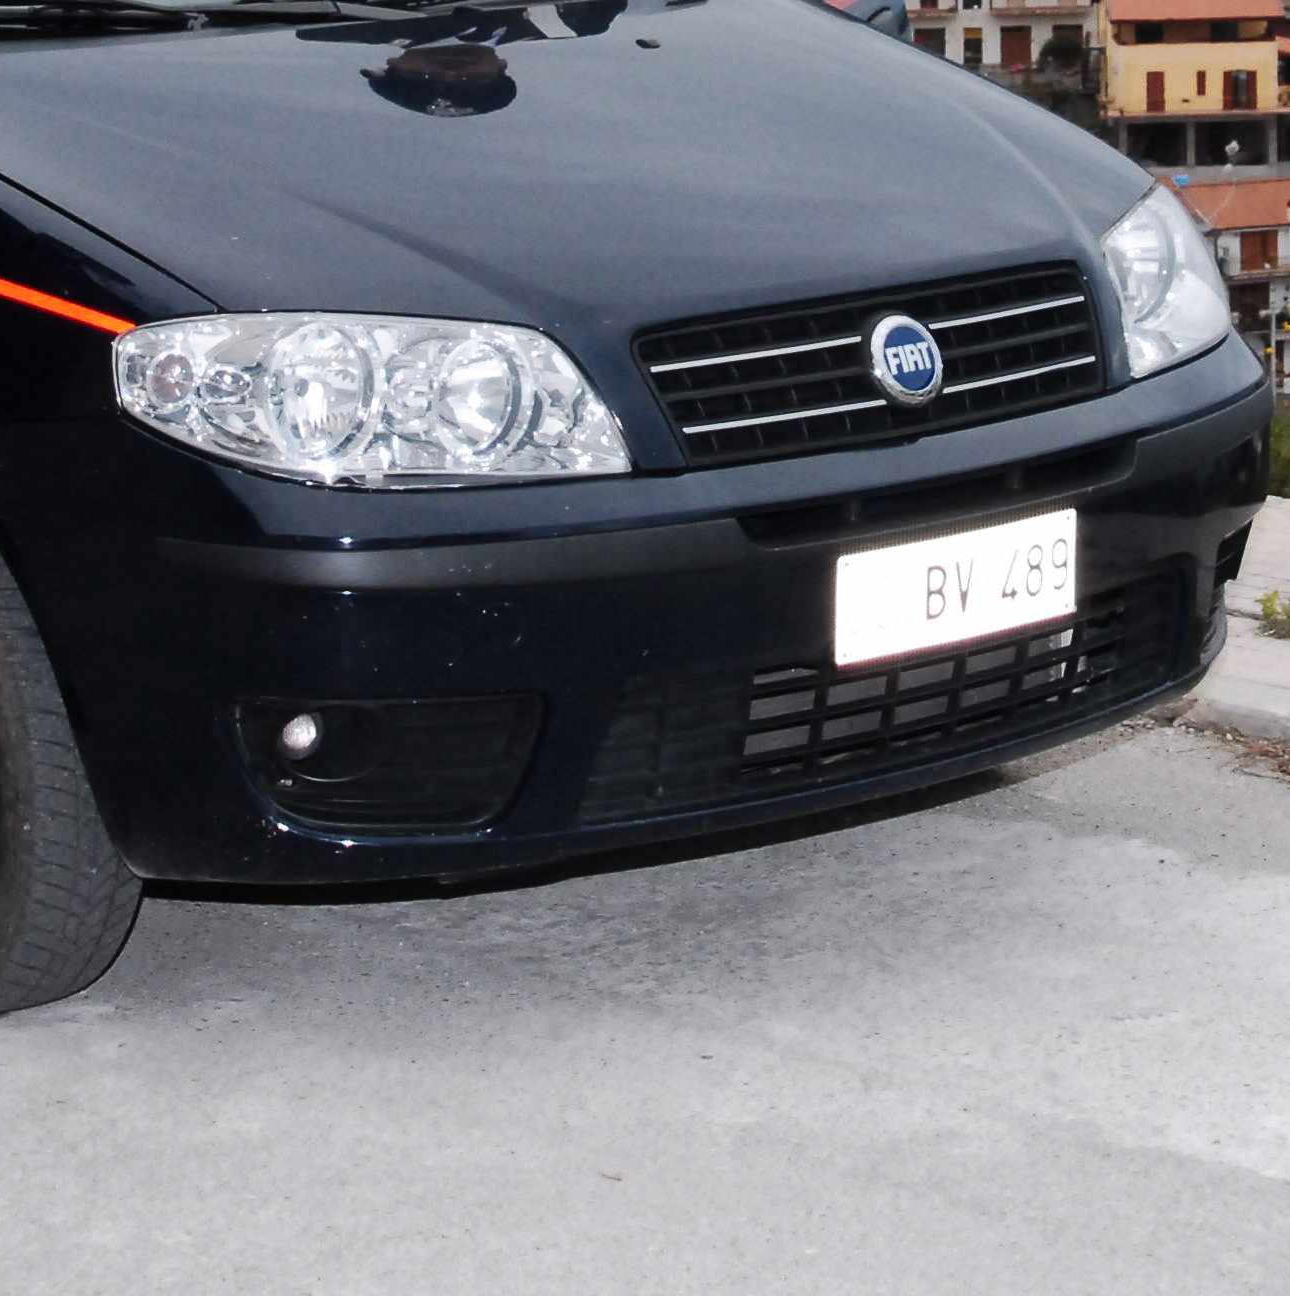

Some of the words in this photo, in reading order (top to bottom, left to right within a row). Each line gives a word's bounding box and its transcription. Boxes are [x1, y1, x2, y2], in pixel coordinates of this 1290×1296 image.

[885, 340, 932, 376] FIAT
[925, 559, 974, 620] BV
[1001, 538, 1069, 600] 489
